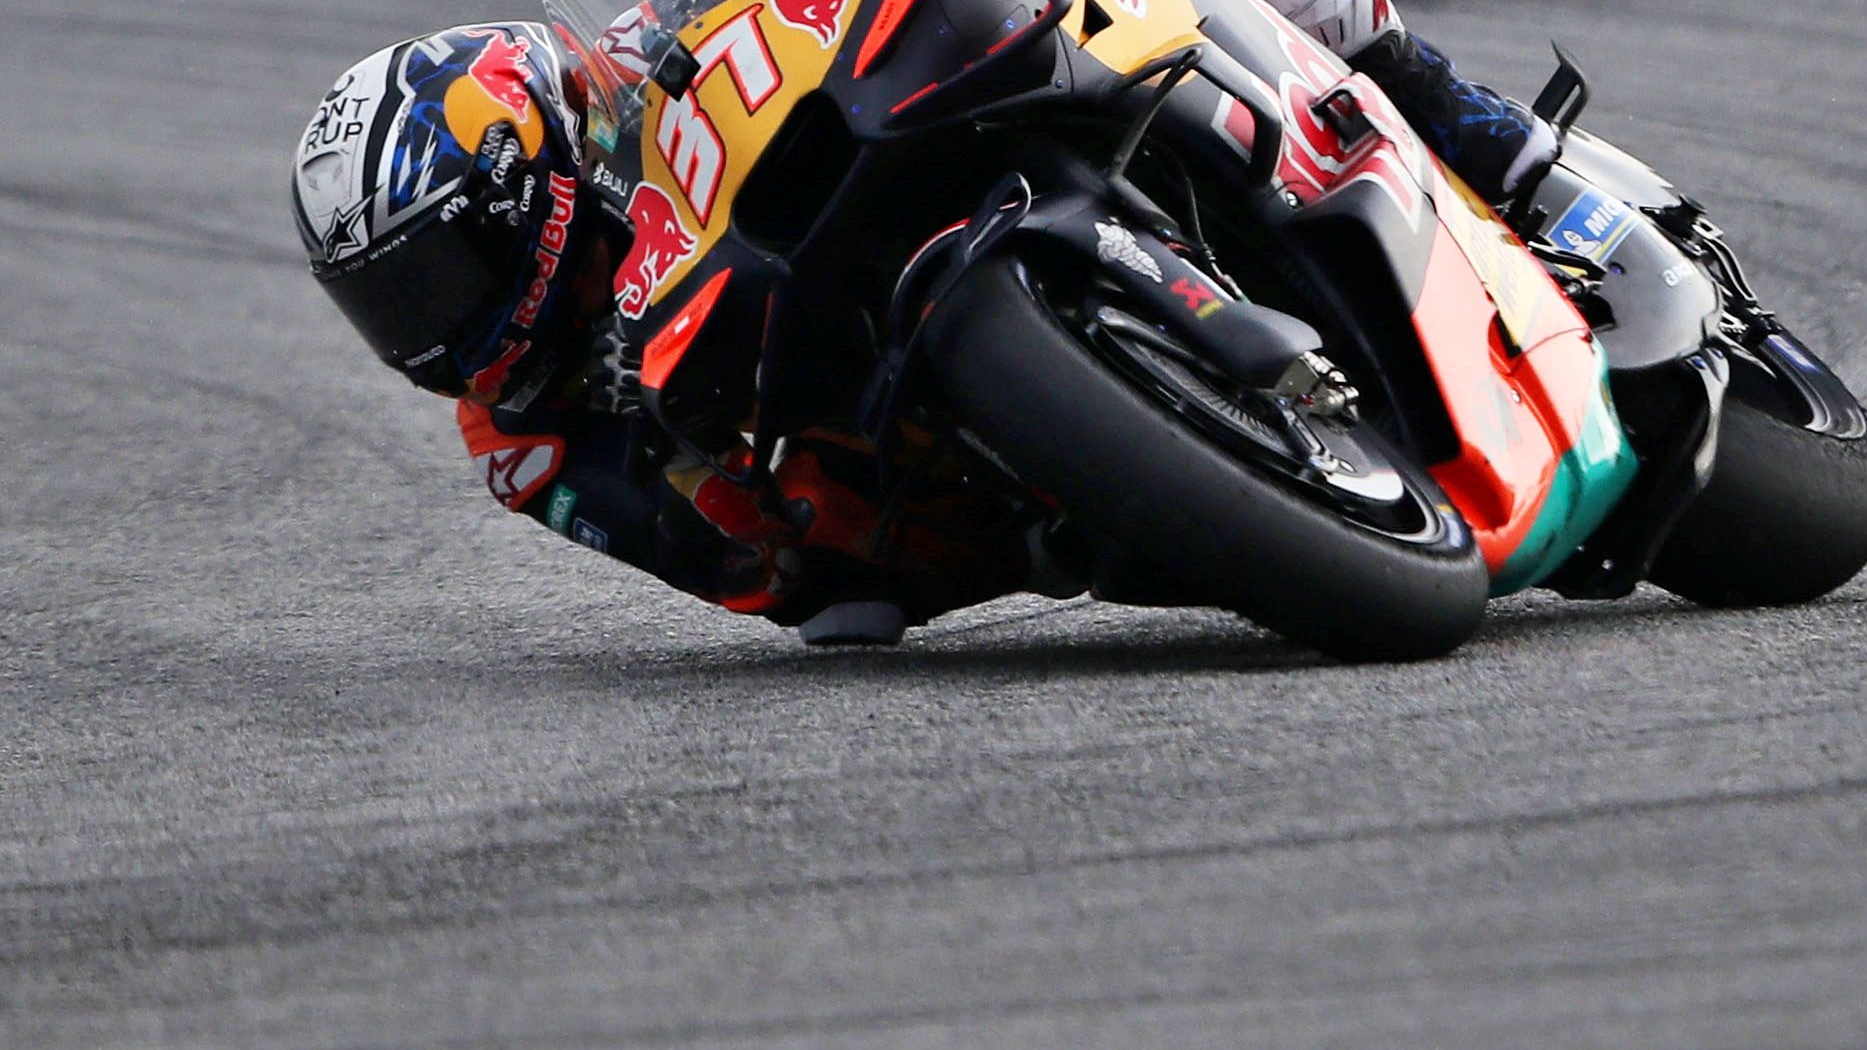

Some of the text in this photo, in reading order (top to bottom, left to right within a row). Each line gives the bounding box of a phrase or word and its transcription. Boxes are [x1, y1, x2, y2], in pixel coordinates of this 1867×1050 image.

[655, 3, 783, 231] 37
[511, 169, 577, 330] Red Bull
